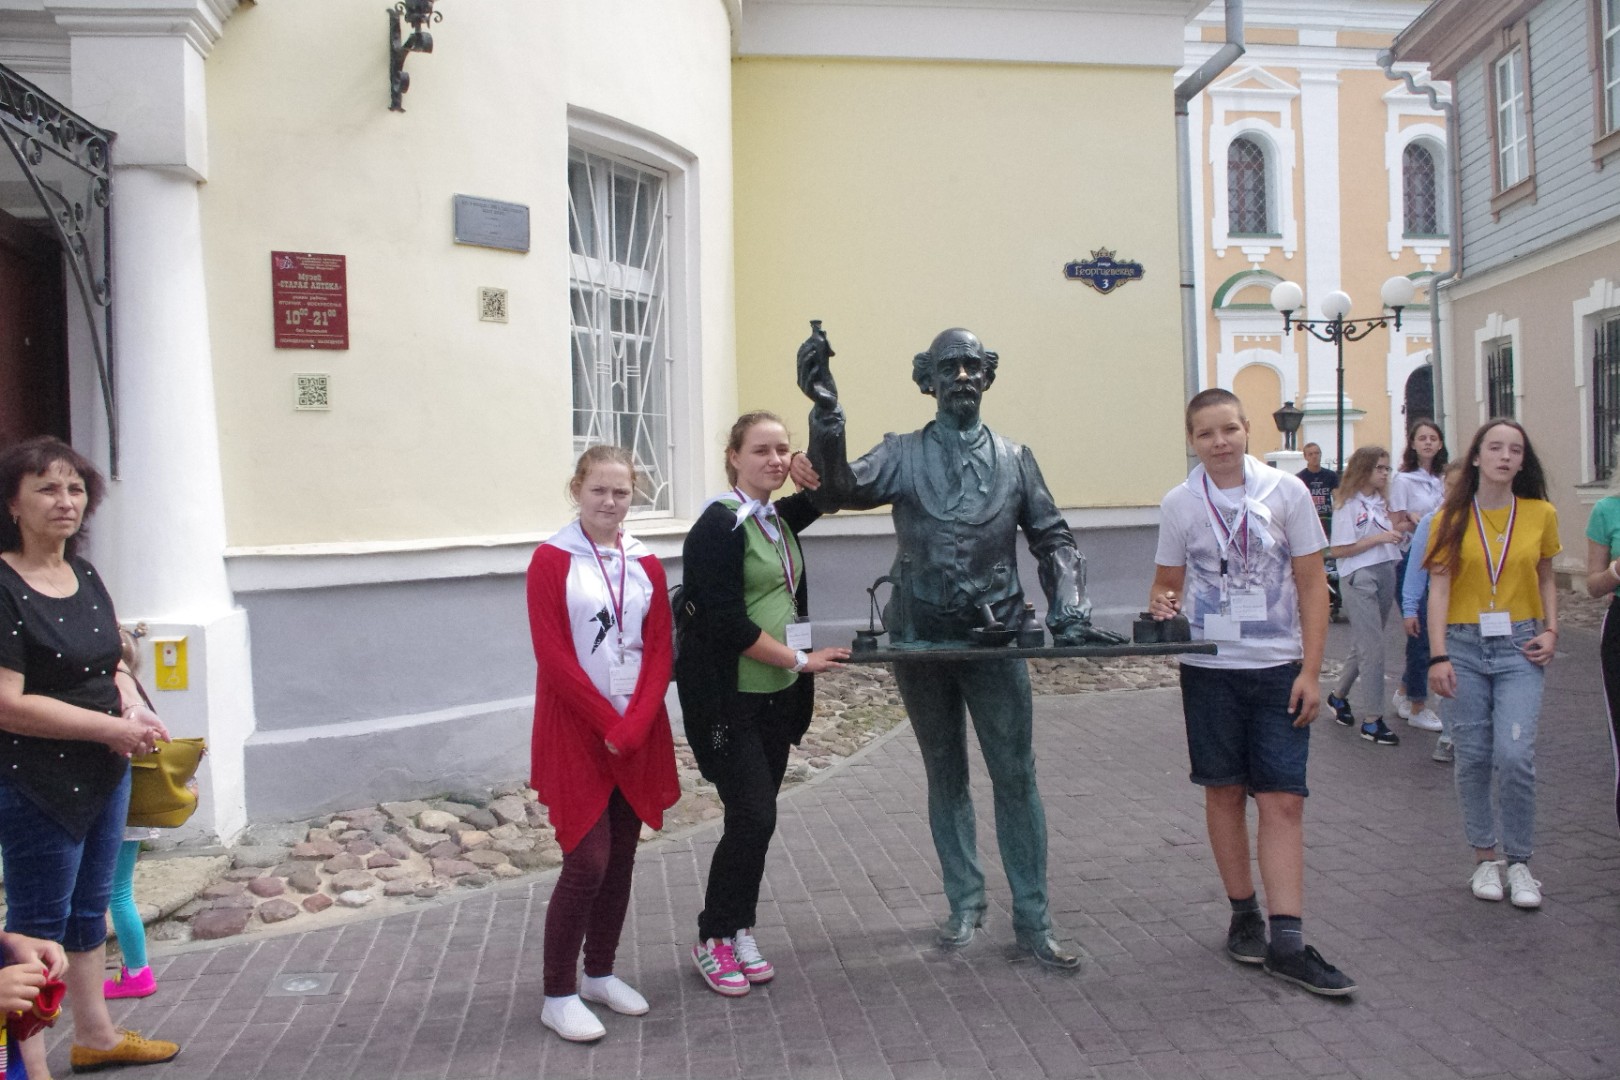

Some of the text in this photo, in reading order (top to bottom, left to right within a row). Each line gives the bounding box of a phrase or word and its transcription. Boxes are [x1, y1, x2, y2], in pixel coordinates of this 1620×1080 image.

[1075, 266, 1135, 276] Георгиевская
[297, 273, 322, 281] Музей
[1102, 279, 1109, 289] 3
